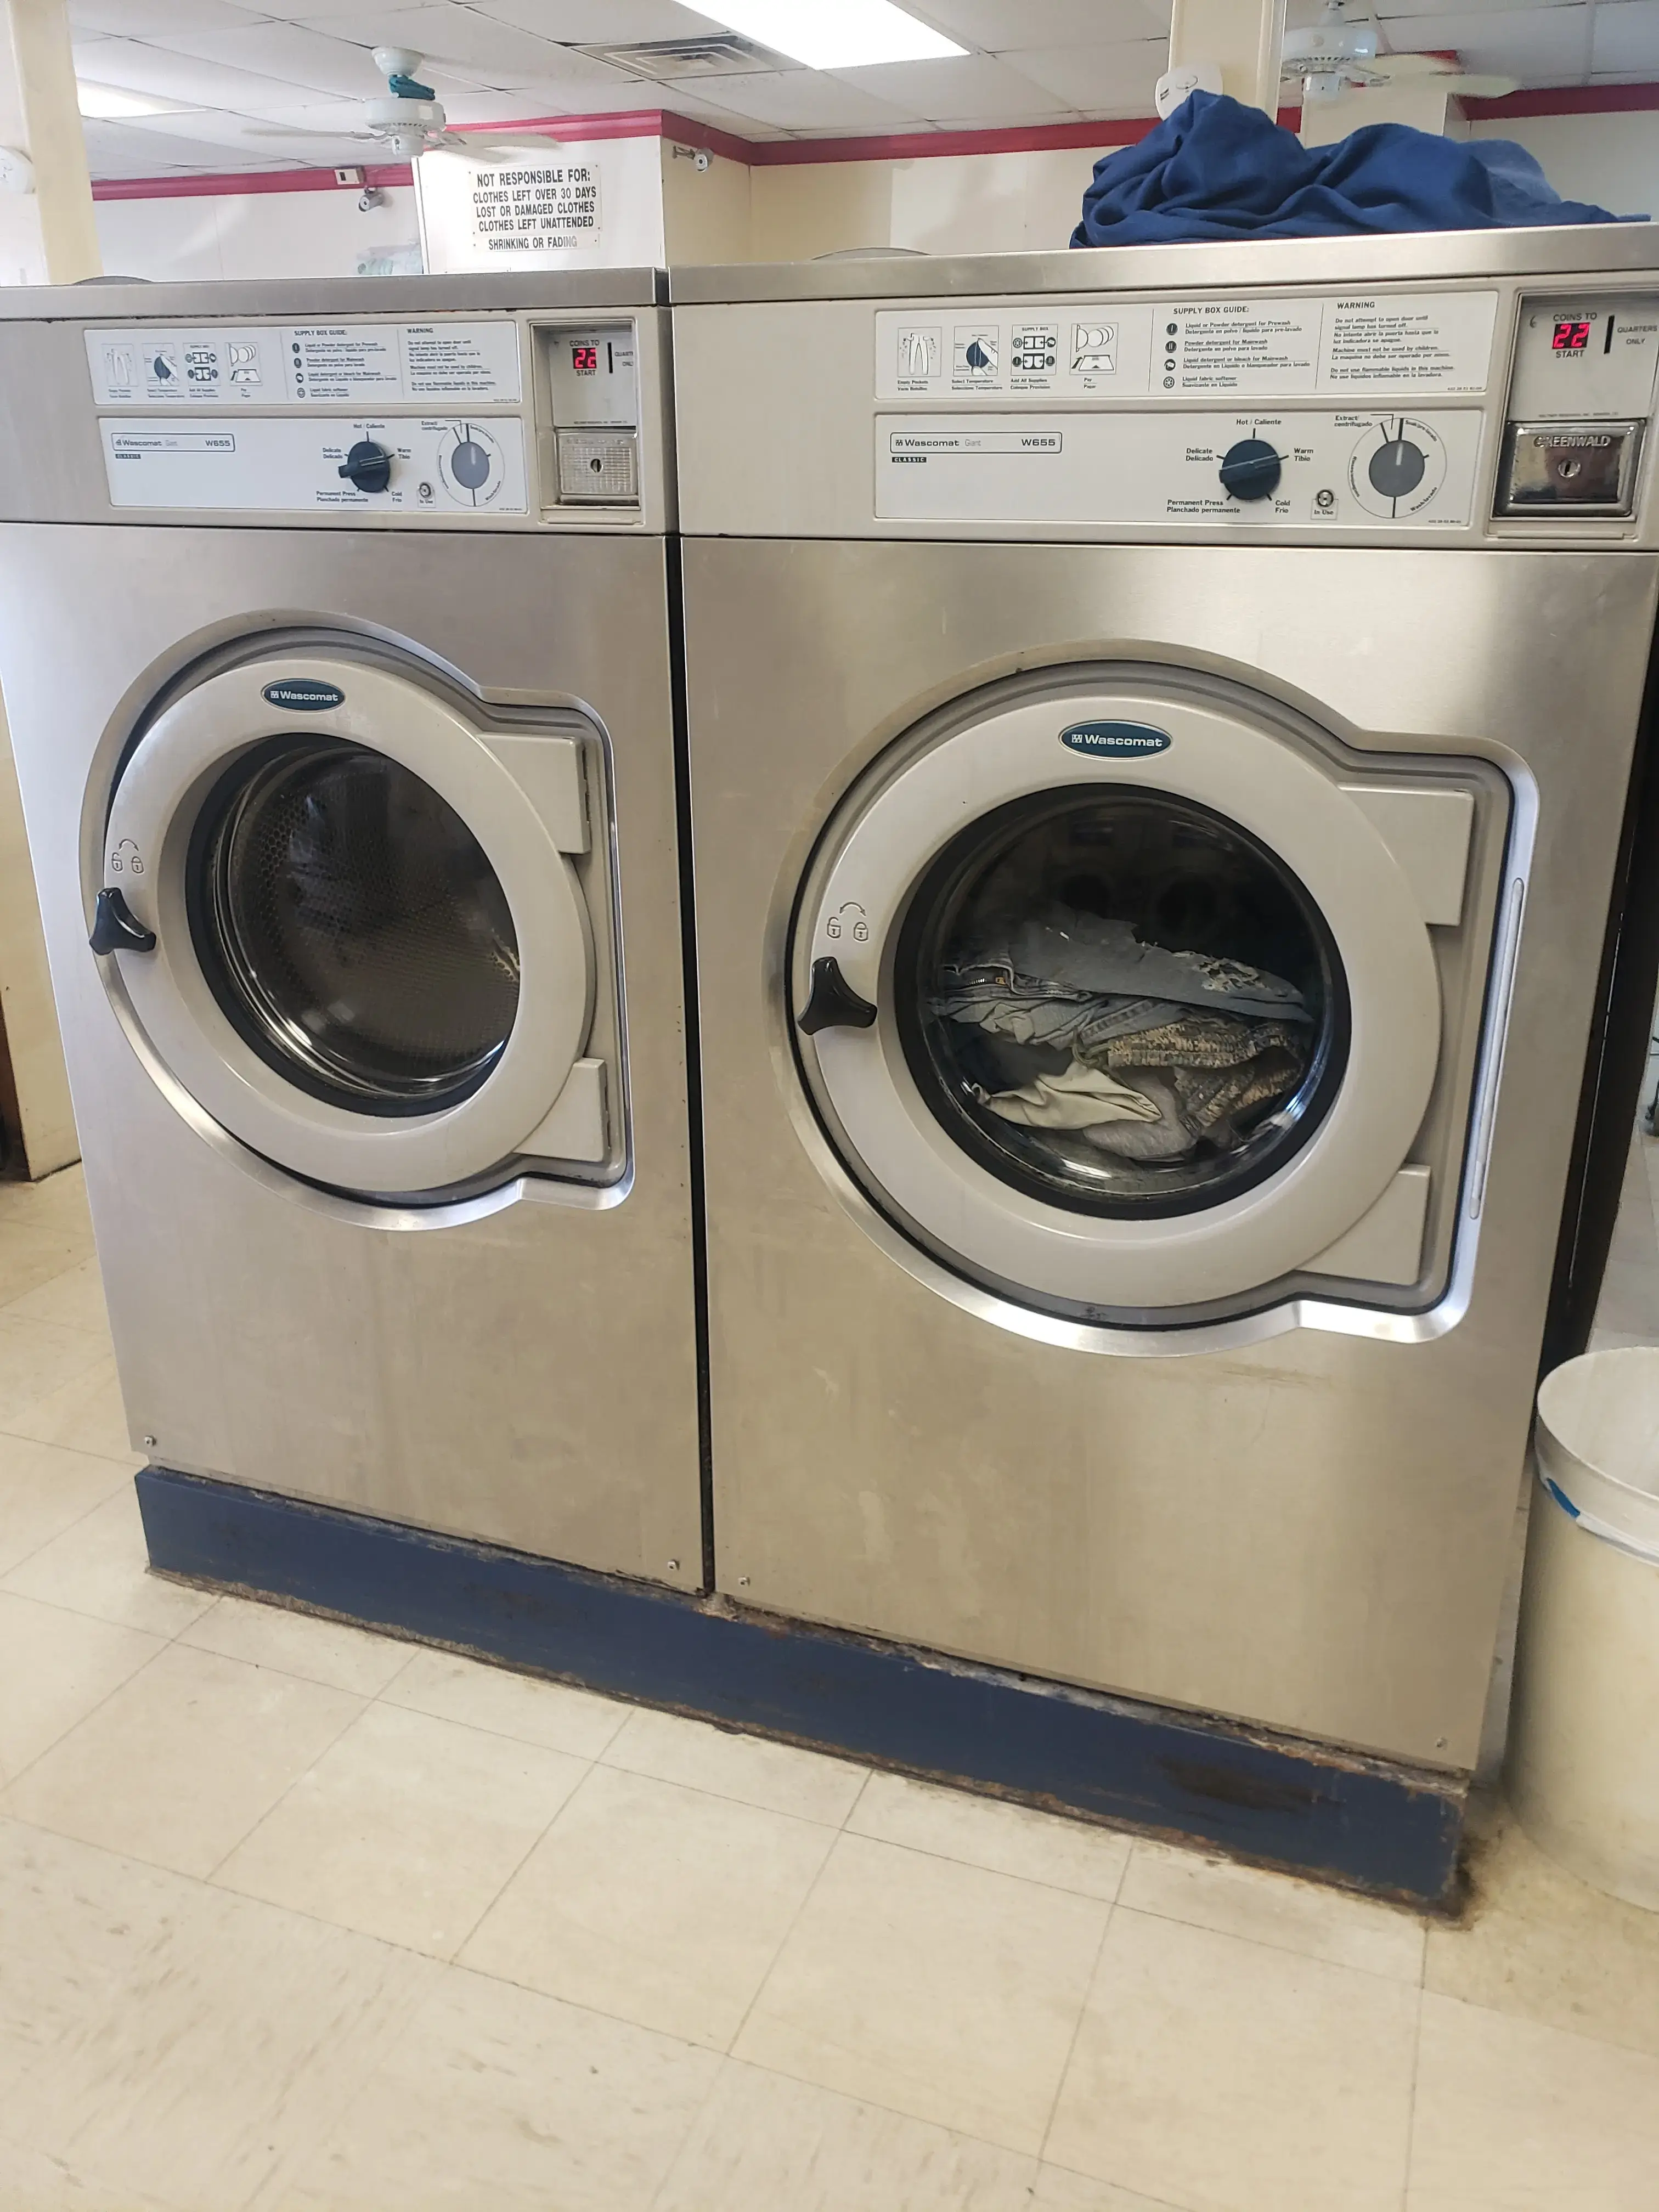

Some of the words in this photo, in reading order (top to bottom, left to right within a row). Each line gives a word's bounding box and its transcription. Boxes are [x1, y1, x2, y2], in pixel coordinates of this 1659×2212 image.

[477, 173, 494, 187] NOT
[500, 170, 563, 185] RESPONSIBLE
[568, 168, 590, 182] FOR:
[473, 190, 508, 203] CLOTHES
[512, 190, 531, 201] LEFT
[535, 189, 557, 200] OVER
[561, 188, 571, 199] 30
[575, 187, 596, 198] DAYS
[477, 206, 495, 217] LOST
[500, 205, 511, 216] OR
[515, 203, 553, 216] DAMAGED
[558, 202, 594, 213] CLOTHES
[479, 221, 514, 232] CLOTHES
[518, 219, 537, 230] LEFT
[541, 216, 594, 229] UNATTENDED
[489, 237, 529, 250] SHRINKING
[533, 237, 544, 248] OR
[548, 235, 577, 248] FADING
[1553, 324, 1589, 348] 22
[1618, 325, 1657, 334] QUARTERS
[575, 349, 596, 368] 22
[1556, 350, 1585, 358] START
[1534, 436, 1611, 447] GREENWALD
[280, 691, 338, 701] Wascomat
[1085, 735, 1163, 747] Wascomat
